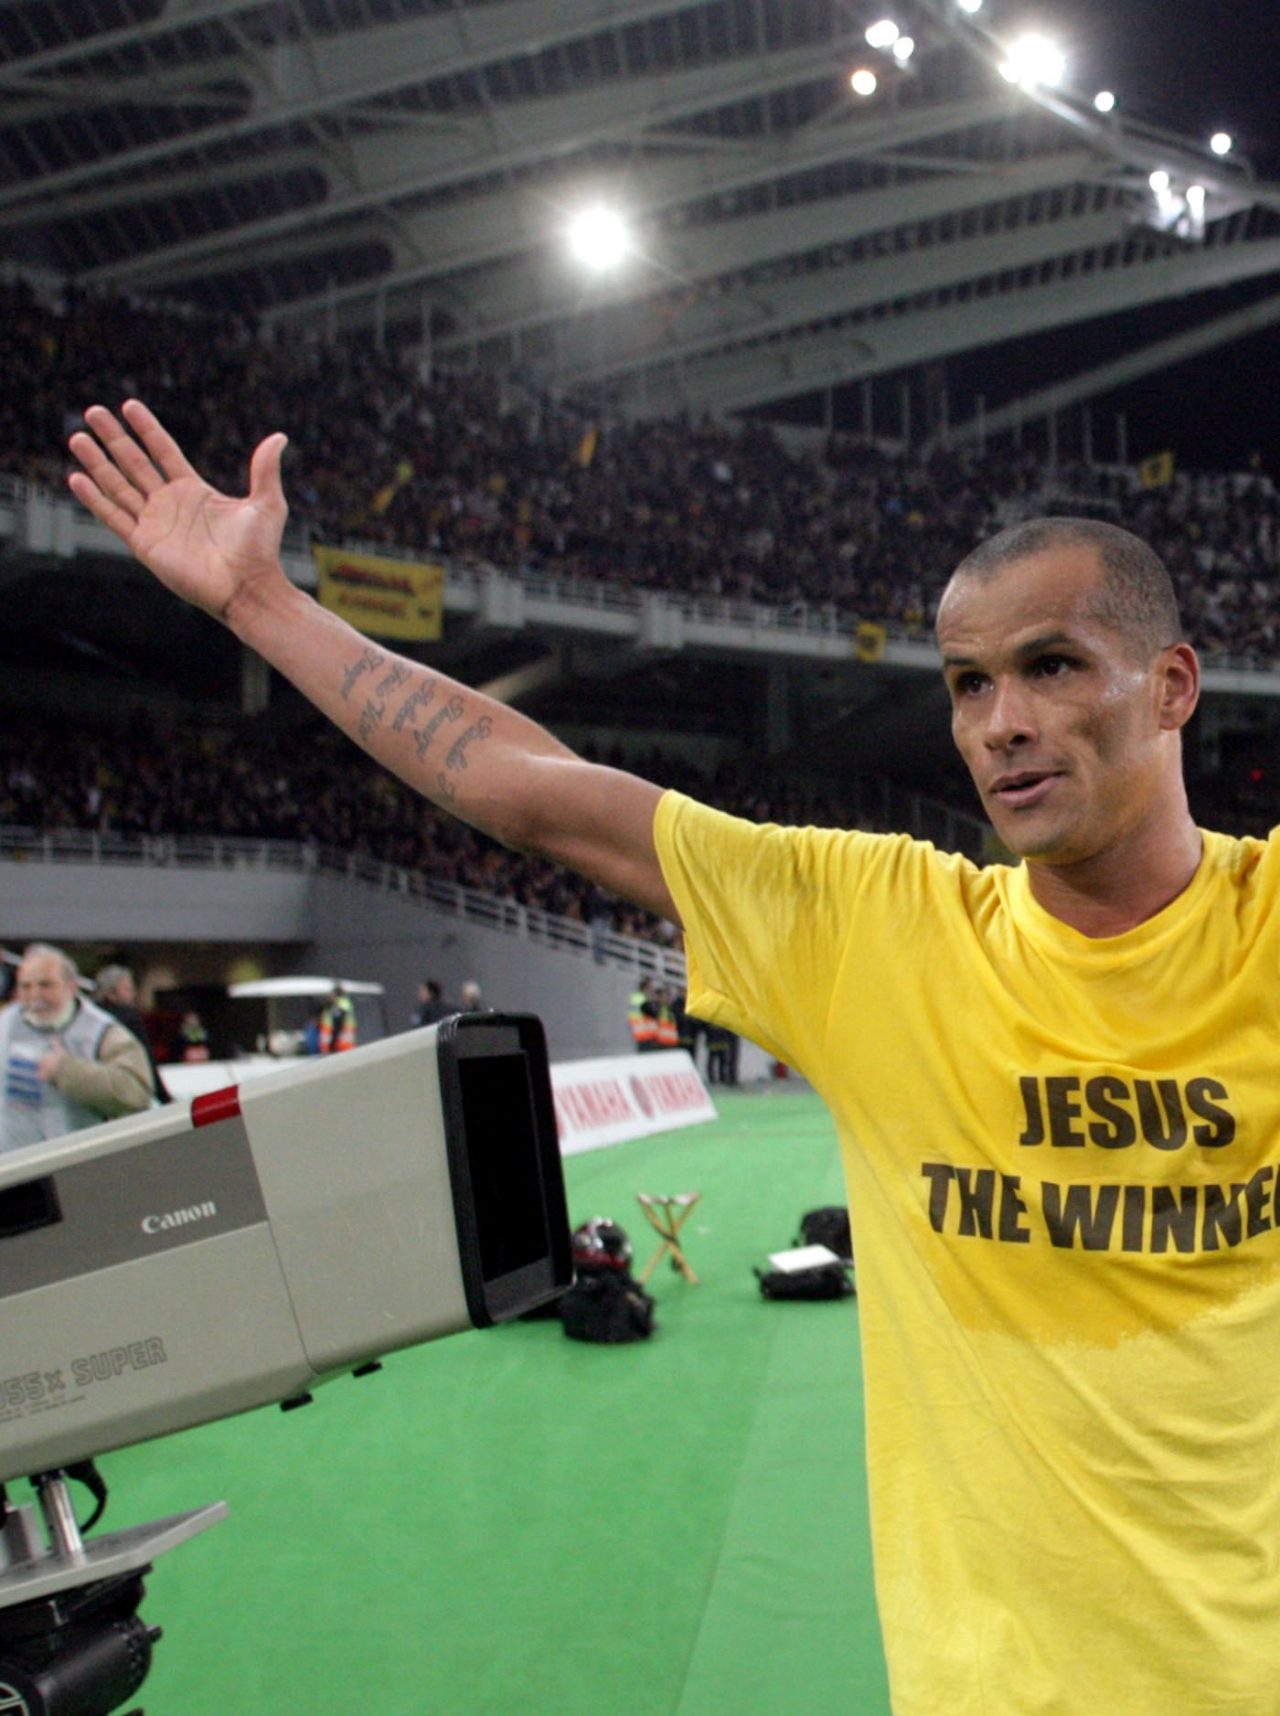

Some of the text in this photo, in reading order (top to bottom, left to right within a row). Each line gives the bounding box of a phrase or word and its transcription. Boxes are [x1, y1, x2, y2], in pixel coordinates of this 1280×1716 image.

[1019, 1075, 1236, 1151] JESUS
[141, 1200, 217, 1235] Canon
[921, 1162, 1031, 1244] THE
[70, 1336, 168, 1387] SUPER
